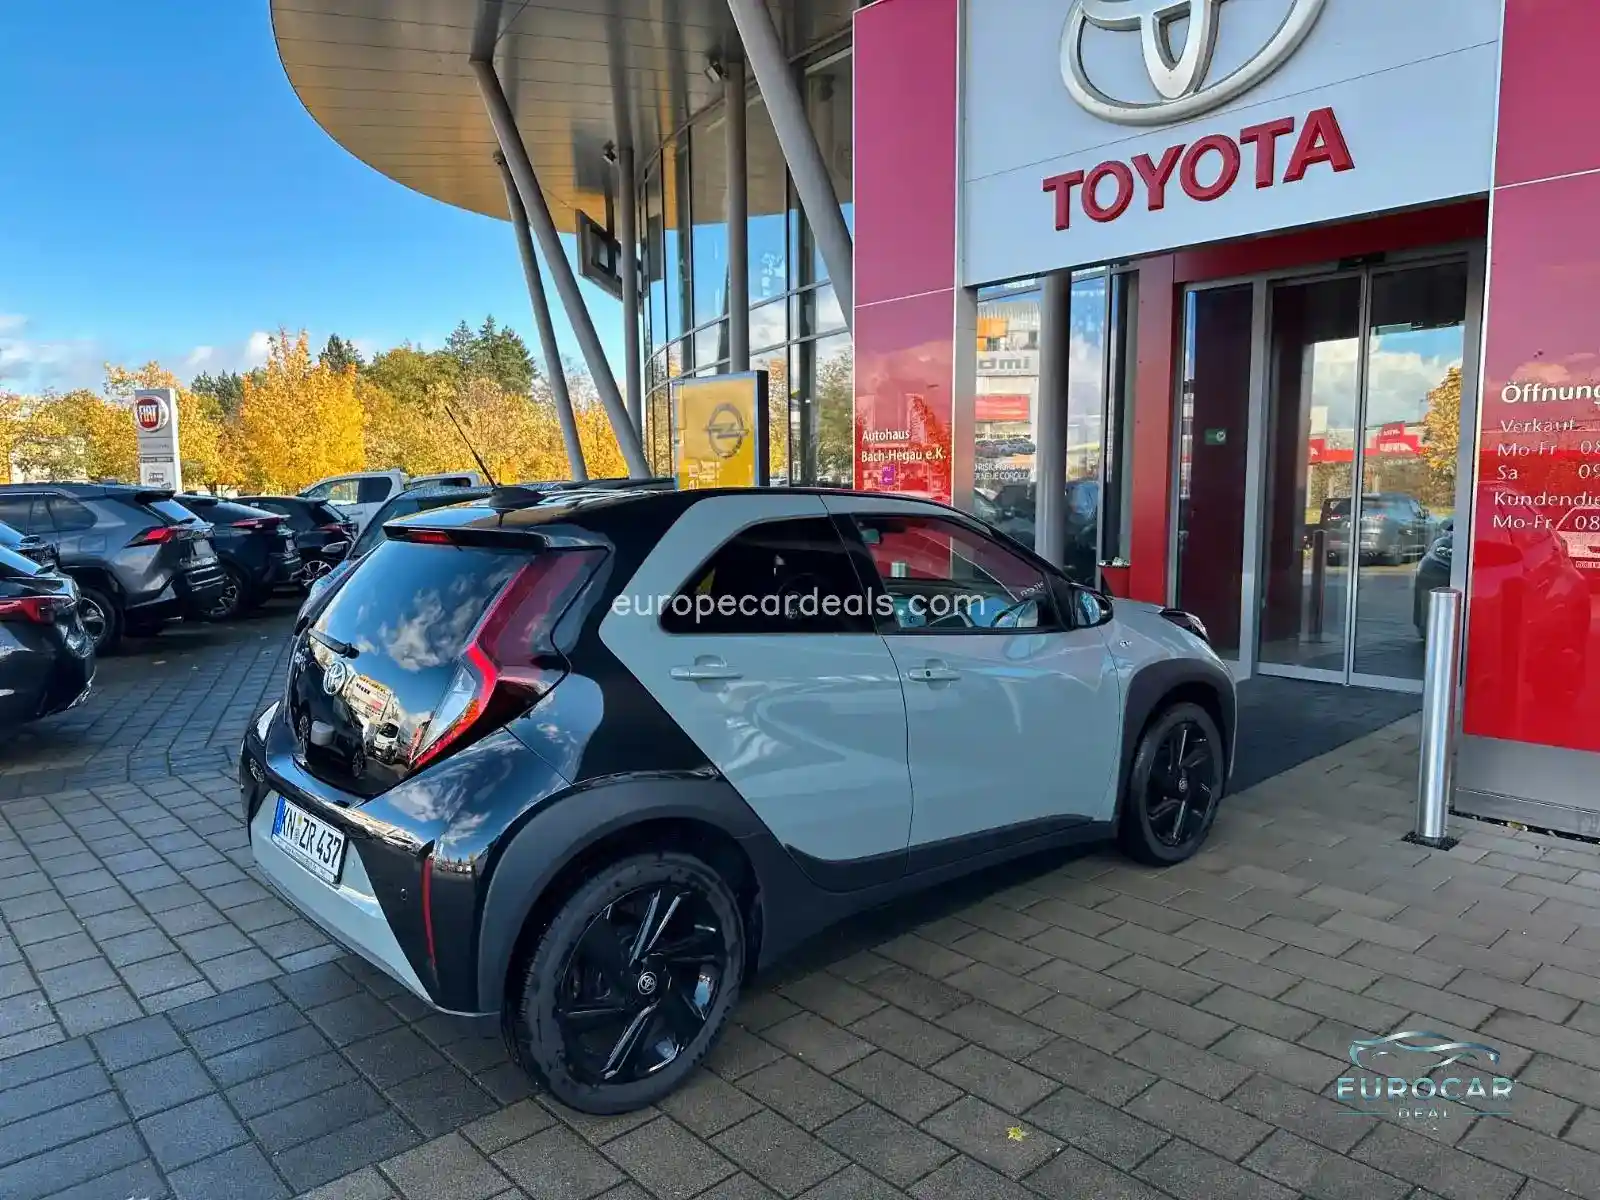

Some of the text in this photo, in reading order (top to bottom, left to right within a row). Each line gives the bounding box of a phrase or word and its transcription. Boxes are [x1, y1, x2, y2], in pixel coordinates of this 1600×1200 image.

[1042, 106, 1355, 231] TOYOTA
[139, 405, 158, 422] FIAT
[1501, 417, 1575, 433] Verkauf
[862, 427, 911, 442] Autohaus
[861, 446, 947, 464] Bach-Hegau e.K.
[1497, 441, 1558, 457] Mo-Fr
[1497, 464, 1518, 480] Sa
[1492, 514, 1600, 530] Mo-Fr 08
[282, 807, 342, 868] KN ZR 437
